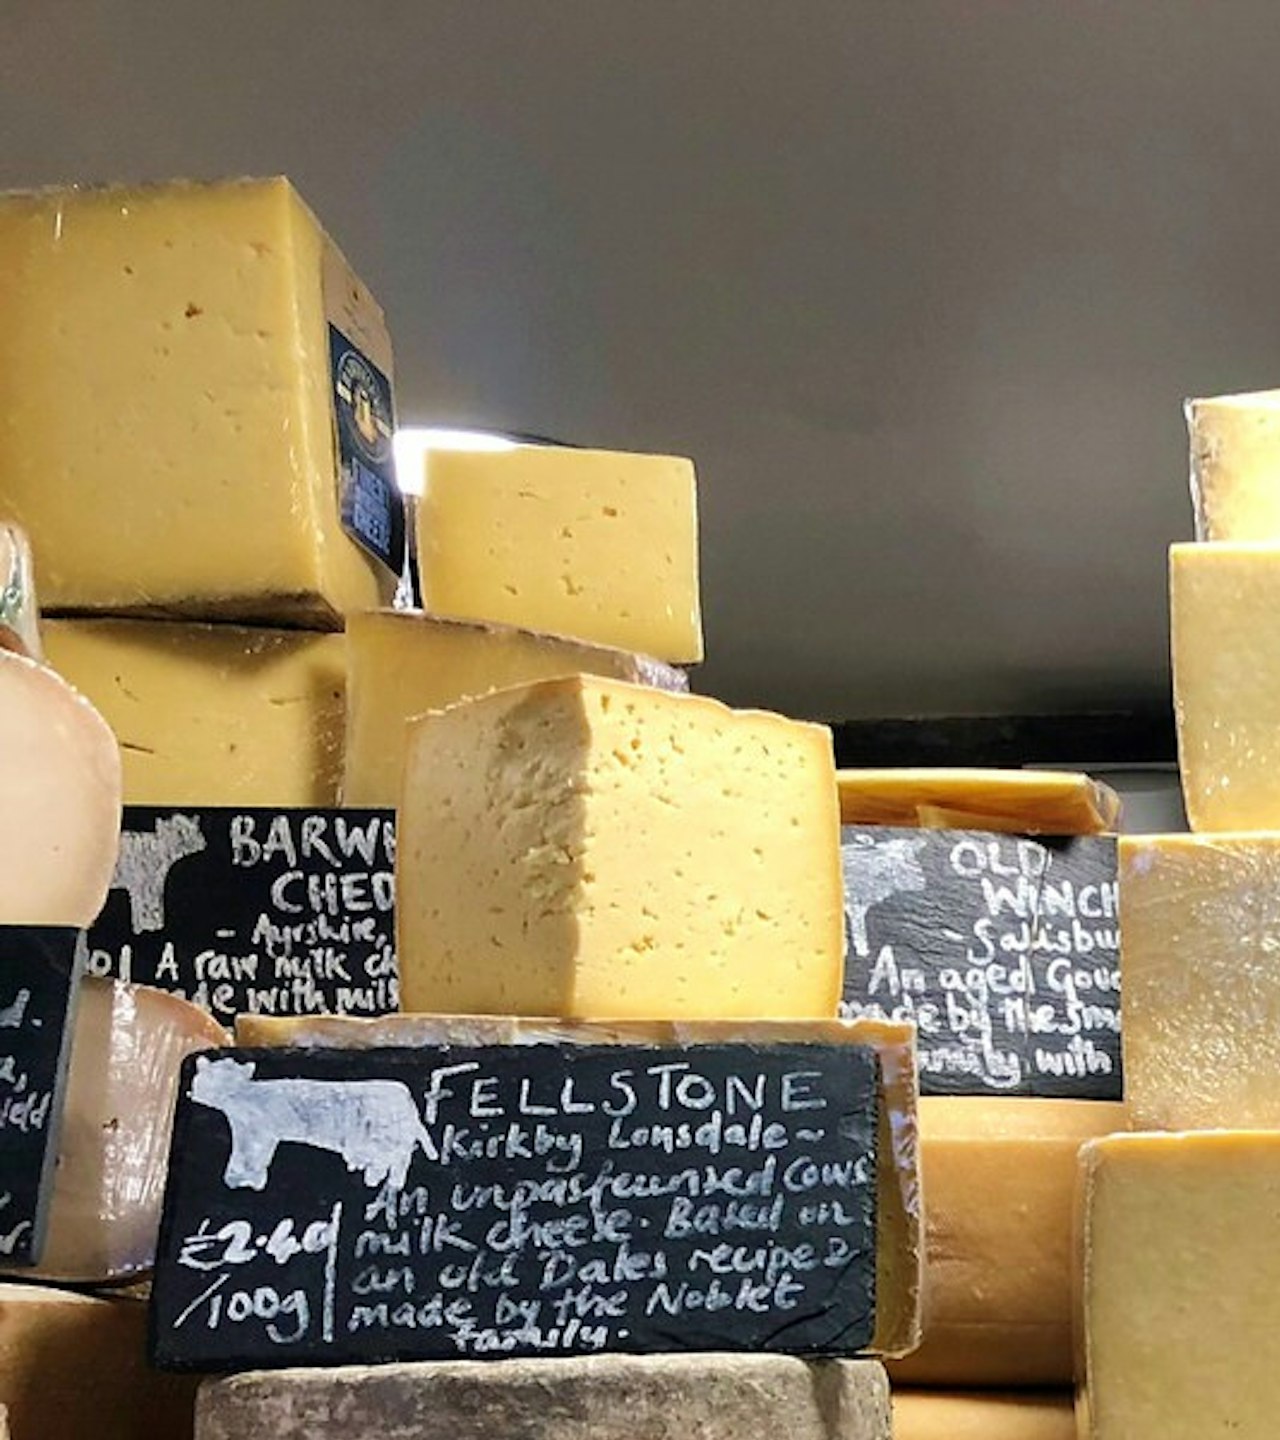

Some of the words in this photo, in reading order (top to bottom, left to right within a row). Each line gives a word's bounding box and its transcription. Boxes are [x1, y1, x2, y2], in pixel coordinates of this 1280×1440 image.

[950, 841, 1048, 878] OLD
[155, 942, 180, 981] A
[195, 949, 259, 982] raw
[868, 944, 926, 997] An
[1036, 1034, 1113, 1078] with
[423, 1061, 828, 1125] FELLSTONE
[440, 1122, 584, 1173] Kirkby
[354, 1212, 478, 1258] milk
[352, 1264, 414, 1294] an
[348, 1293, 478, 1332] made
[555, 1285, 629, 1326] the
